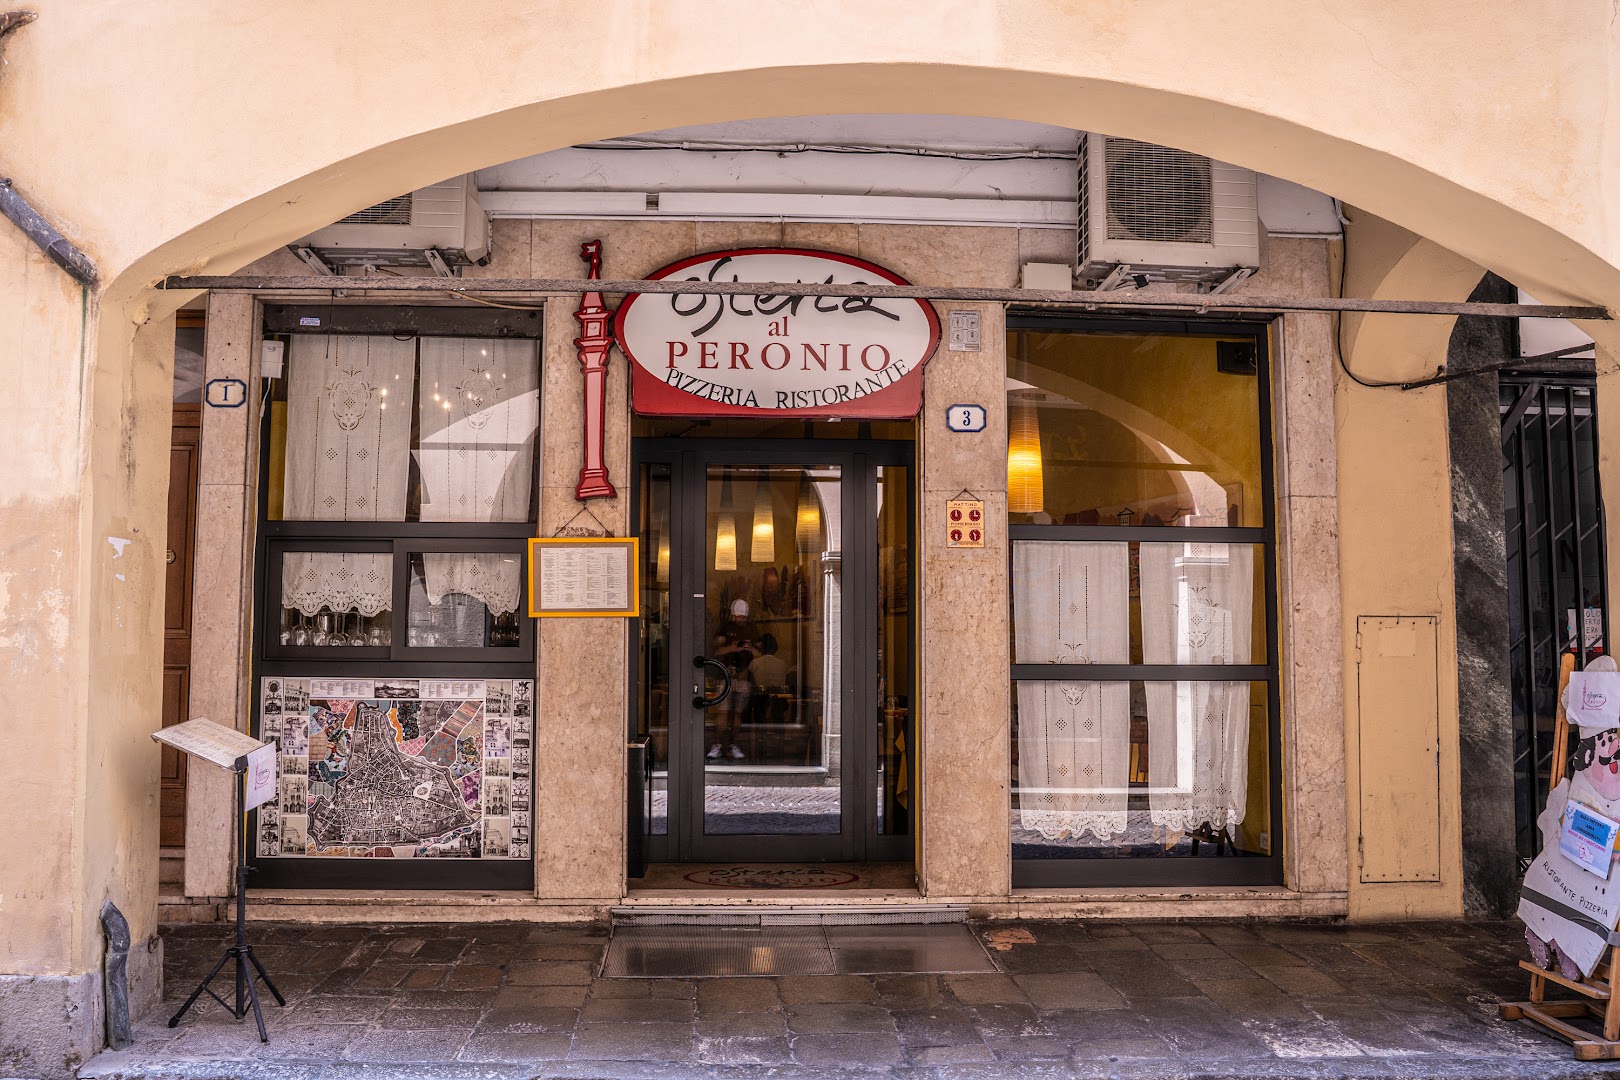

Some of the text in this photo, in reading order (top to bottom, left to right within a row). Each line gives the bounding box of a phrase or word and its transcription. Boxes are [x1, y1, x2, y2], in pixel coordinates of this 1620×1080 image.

[768, 316, 789, 337] al
[665, 341, 891, 371] PERONIO
[222, 385, 229, 401] 1
[664, 359, 910, 409] PIZZERIA RISTORANTE
[962, 410, 971, 426] 3
[1543, 861, 1608, 917] RISTORANTE PIZZERIA
